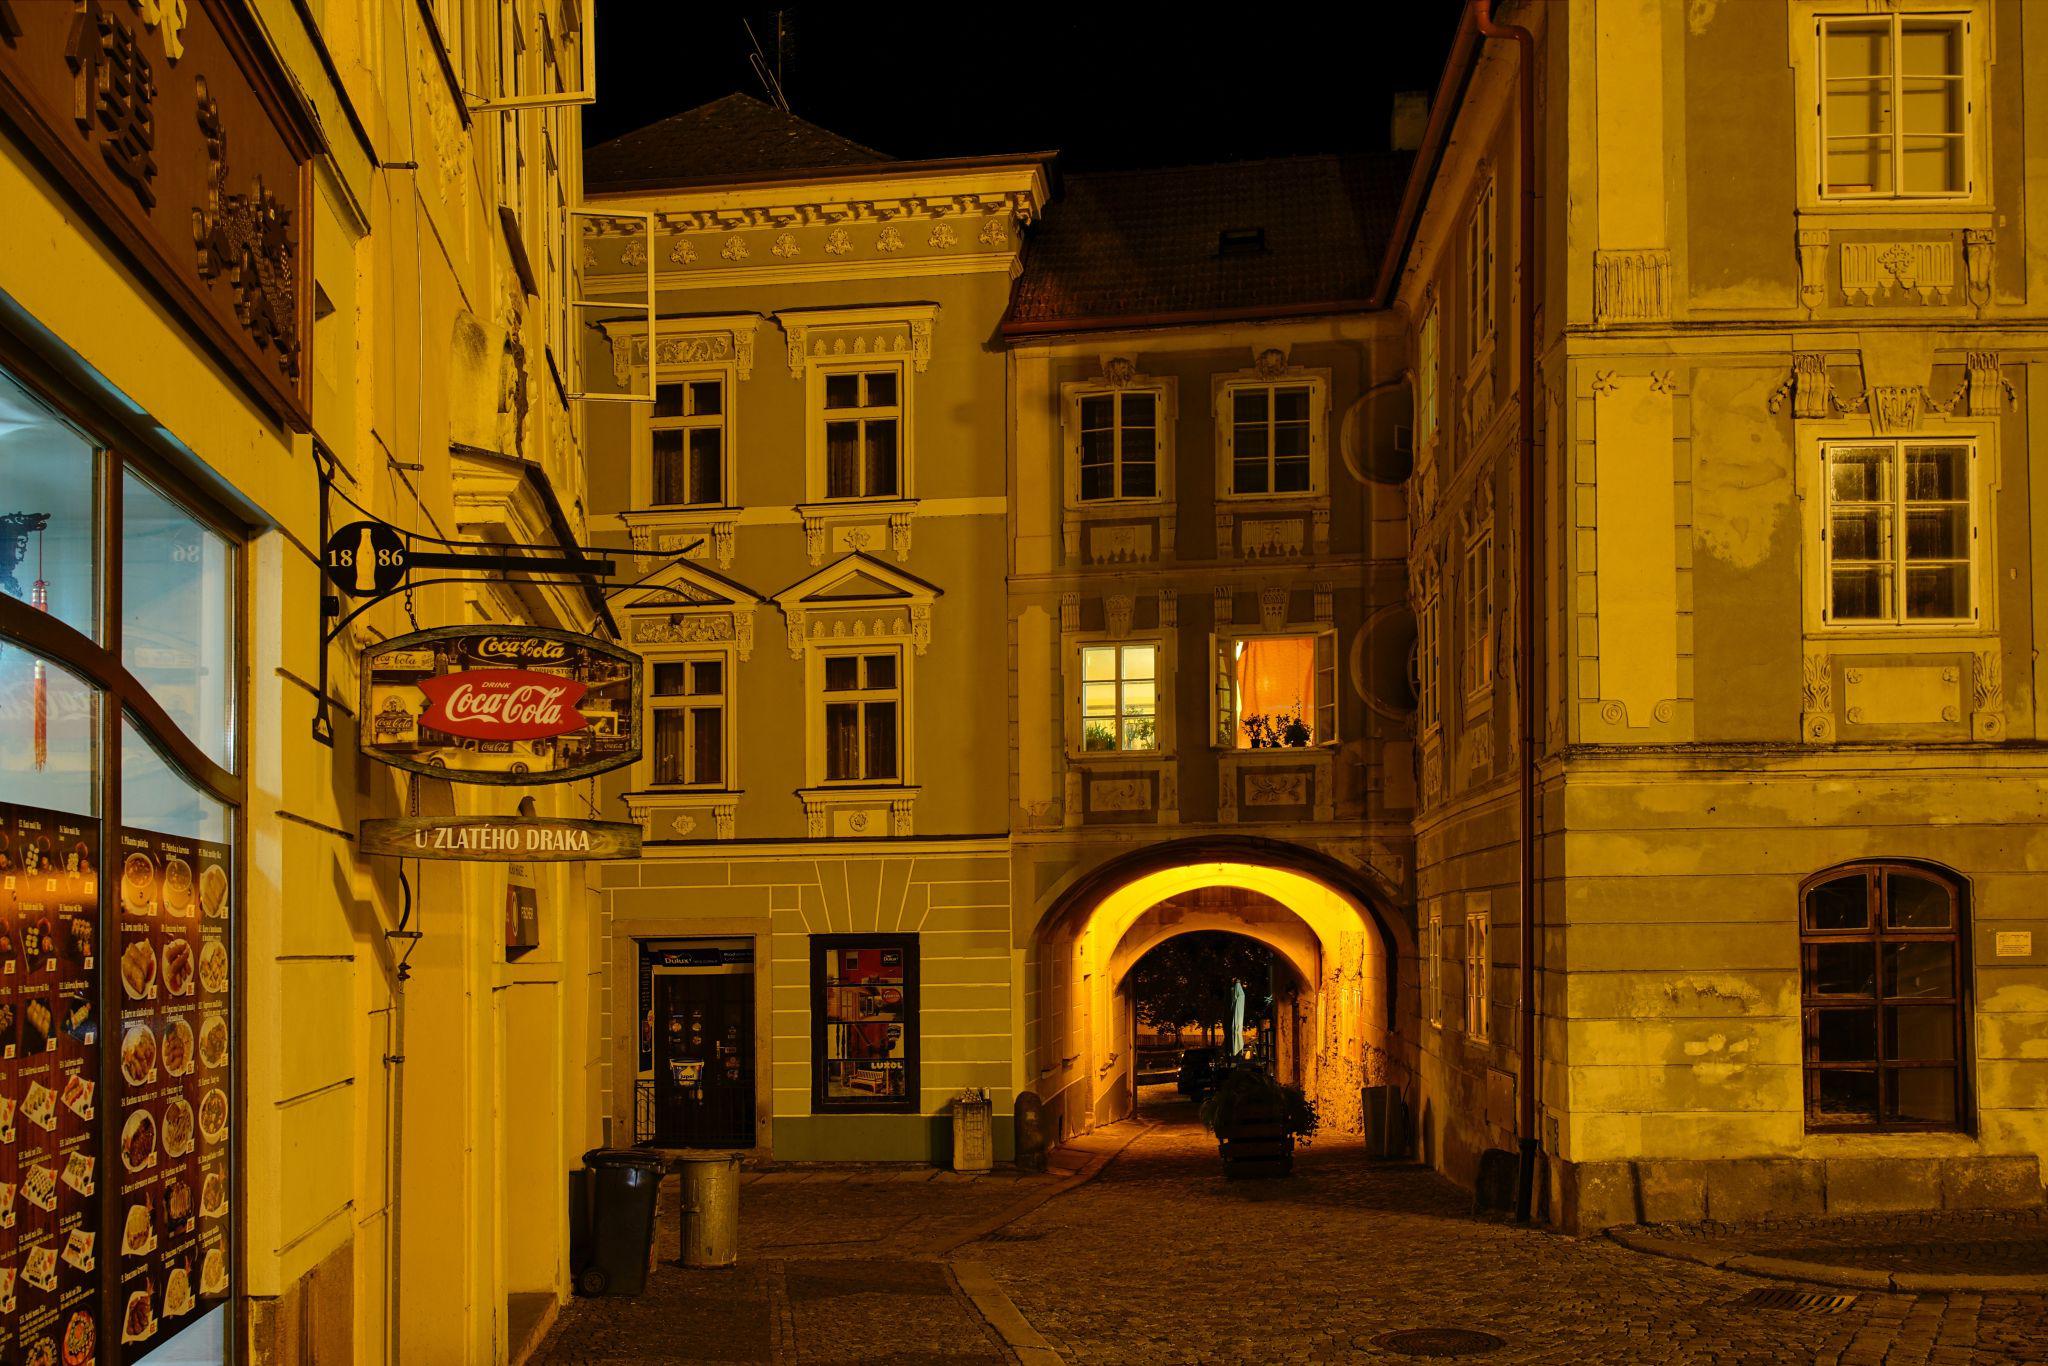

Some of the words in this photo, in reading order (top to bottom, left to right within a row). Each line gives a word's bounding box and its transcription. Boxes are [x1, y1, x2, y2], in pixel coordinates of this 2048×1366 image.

[328, 549, 353, 567] 18
[378, 548, 404, 567] 86
[478, 636, 565, 658] Coca-Cola
[445, 683, 567, 724] Coca-Cola
[415, 828, 428, 849] U
[434, 823, 519, 850] ZLATÉHO
[526, 829, 590, 851] DRAKA
[665, 956, 689, 966] Dulux
[870, 1061, 903, 1070] LUXOL
